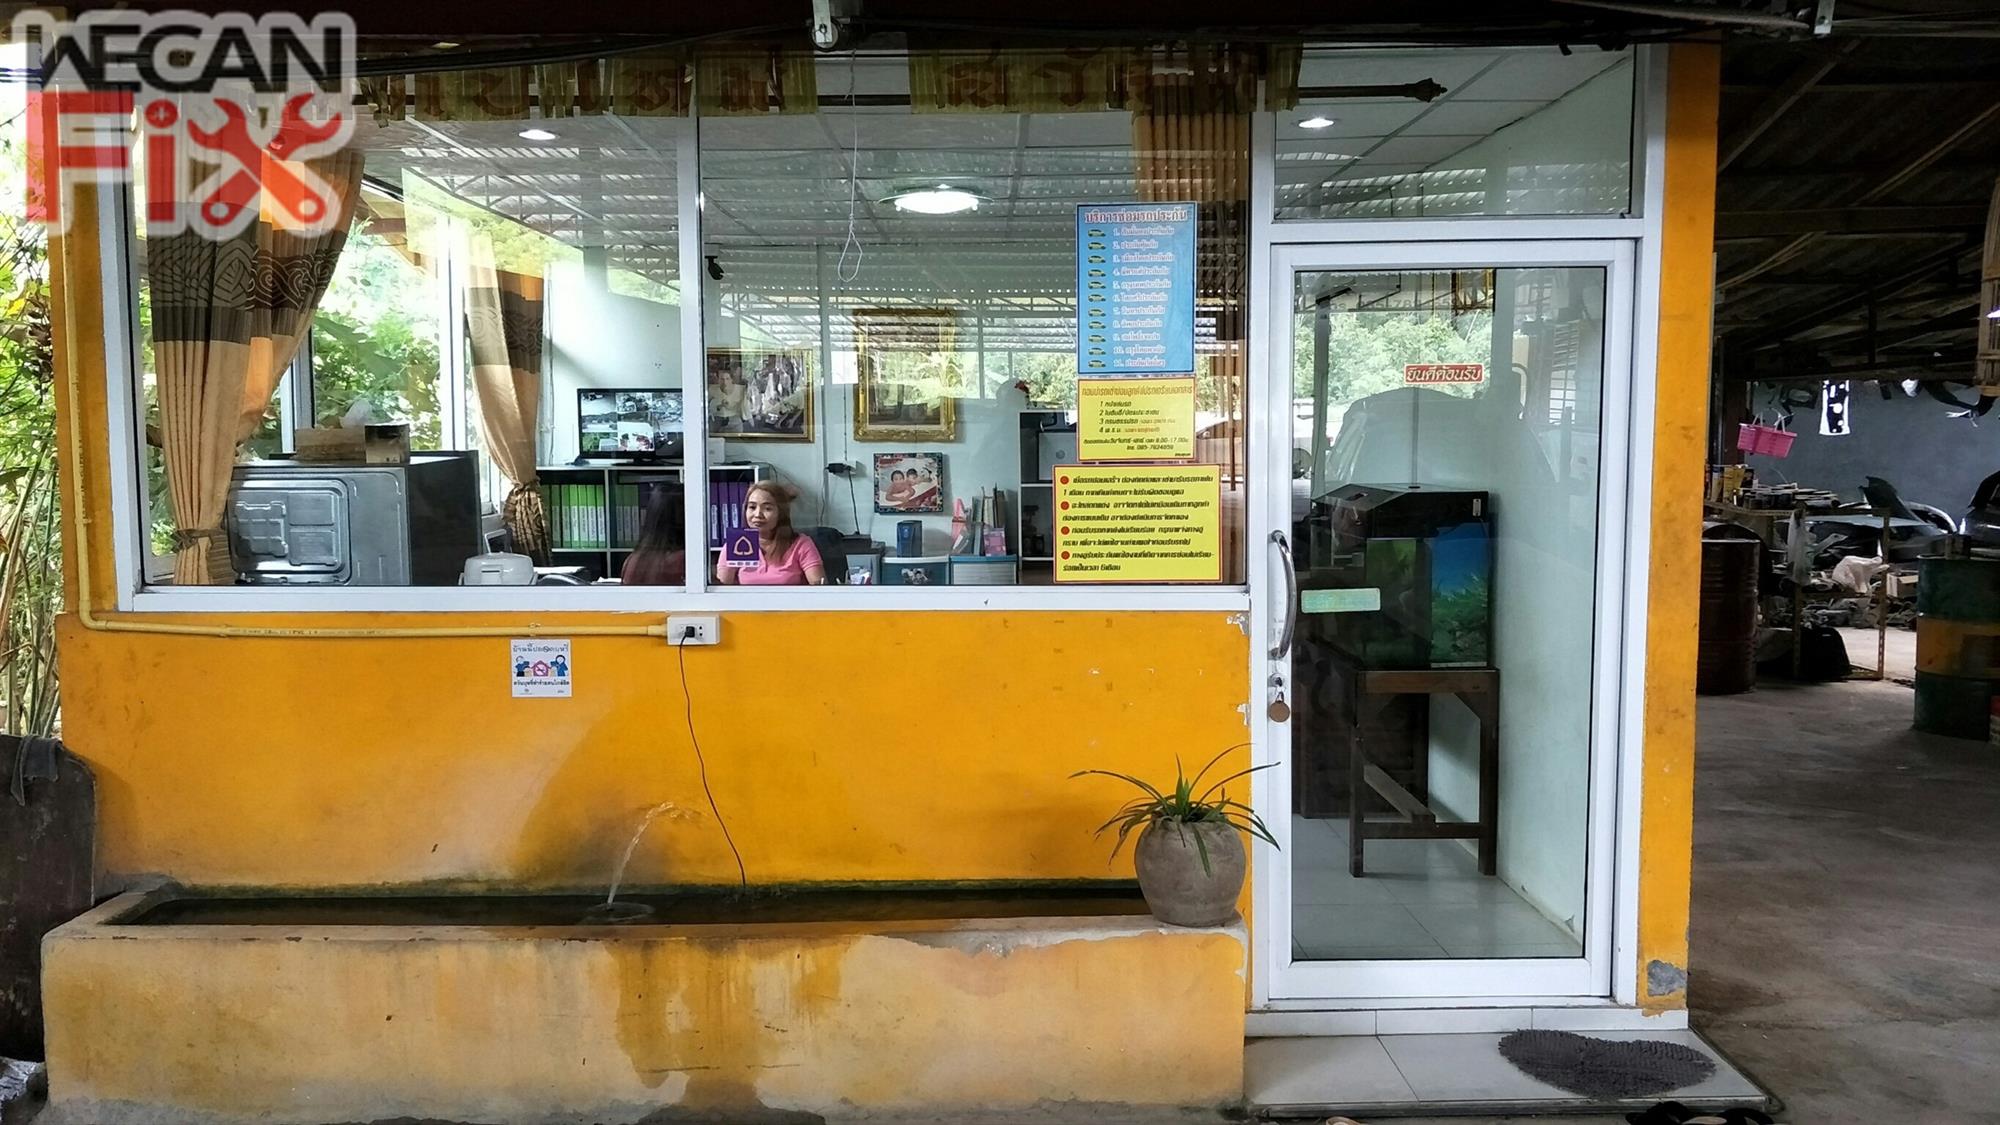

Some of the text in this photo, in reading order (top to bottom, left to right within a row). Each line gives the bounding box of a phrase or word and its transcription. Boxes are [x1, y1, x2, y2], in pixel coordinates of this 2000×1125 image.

[1407, 366, 1482, 381] ยินดีต้อนรับ
